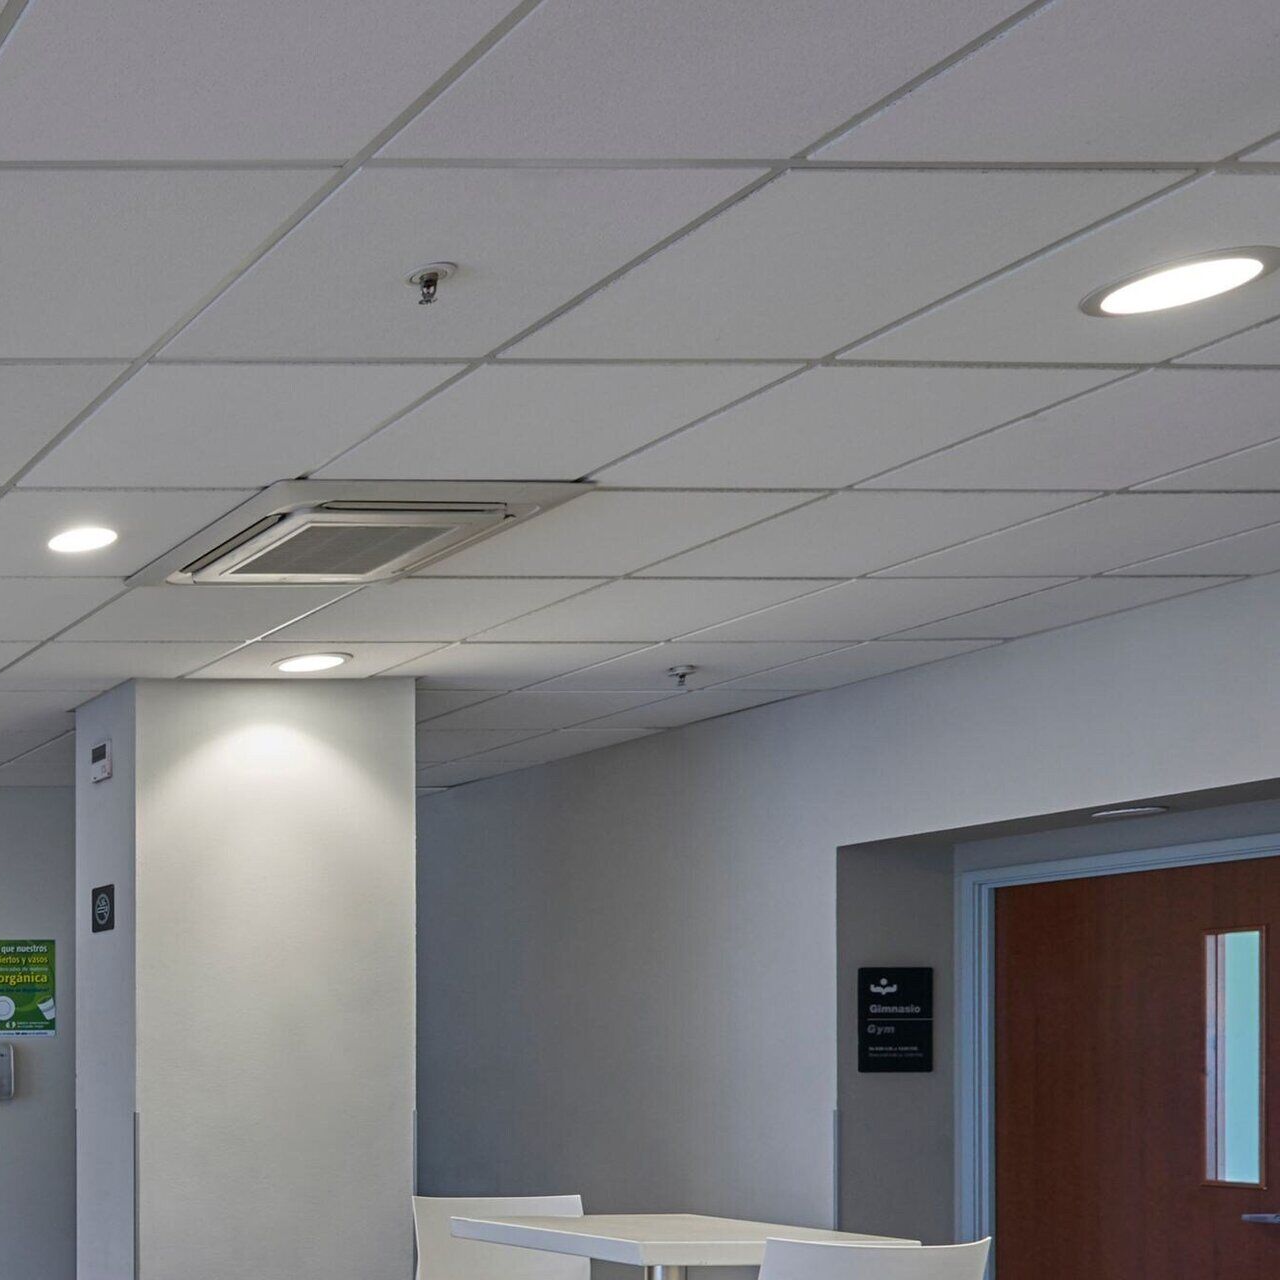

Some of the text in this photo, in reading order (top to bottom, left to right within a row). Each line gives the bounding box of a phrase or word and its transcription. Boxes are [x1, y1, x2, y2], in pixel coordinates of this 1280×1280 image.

[1, 946, 15, 954] que
[16, 945, 48, 953] nuestros
[21, 957, 26, 965] y
[870, 1004, 921, 1013] Gimnasio
[867, 1024, 895, 1035] Gym
